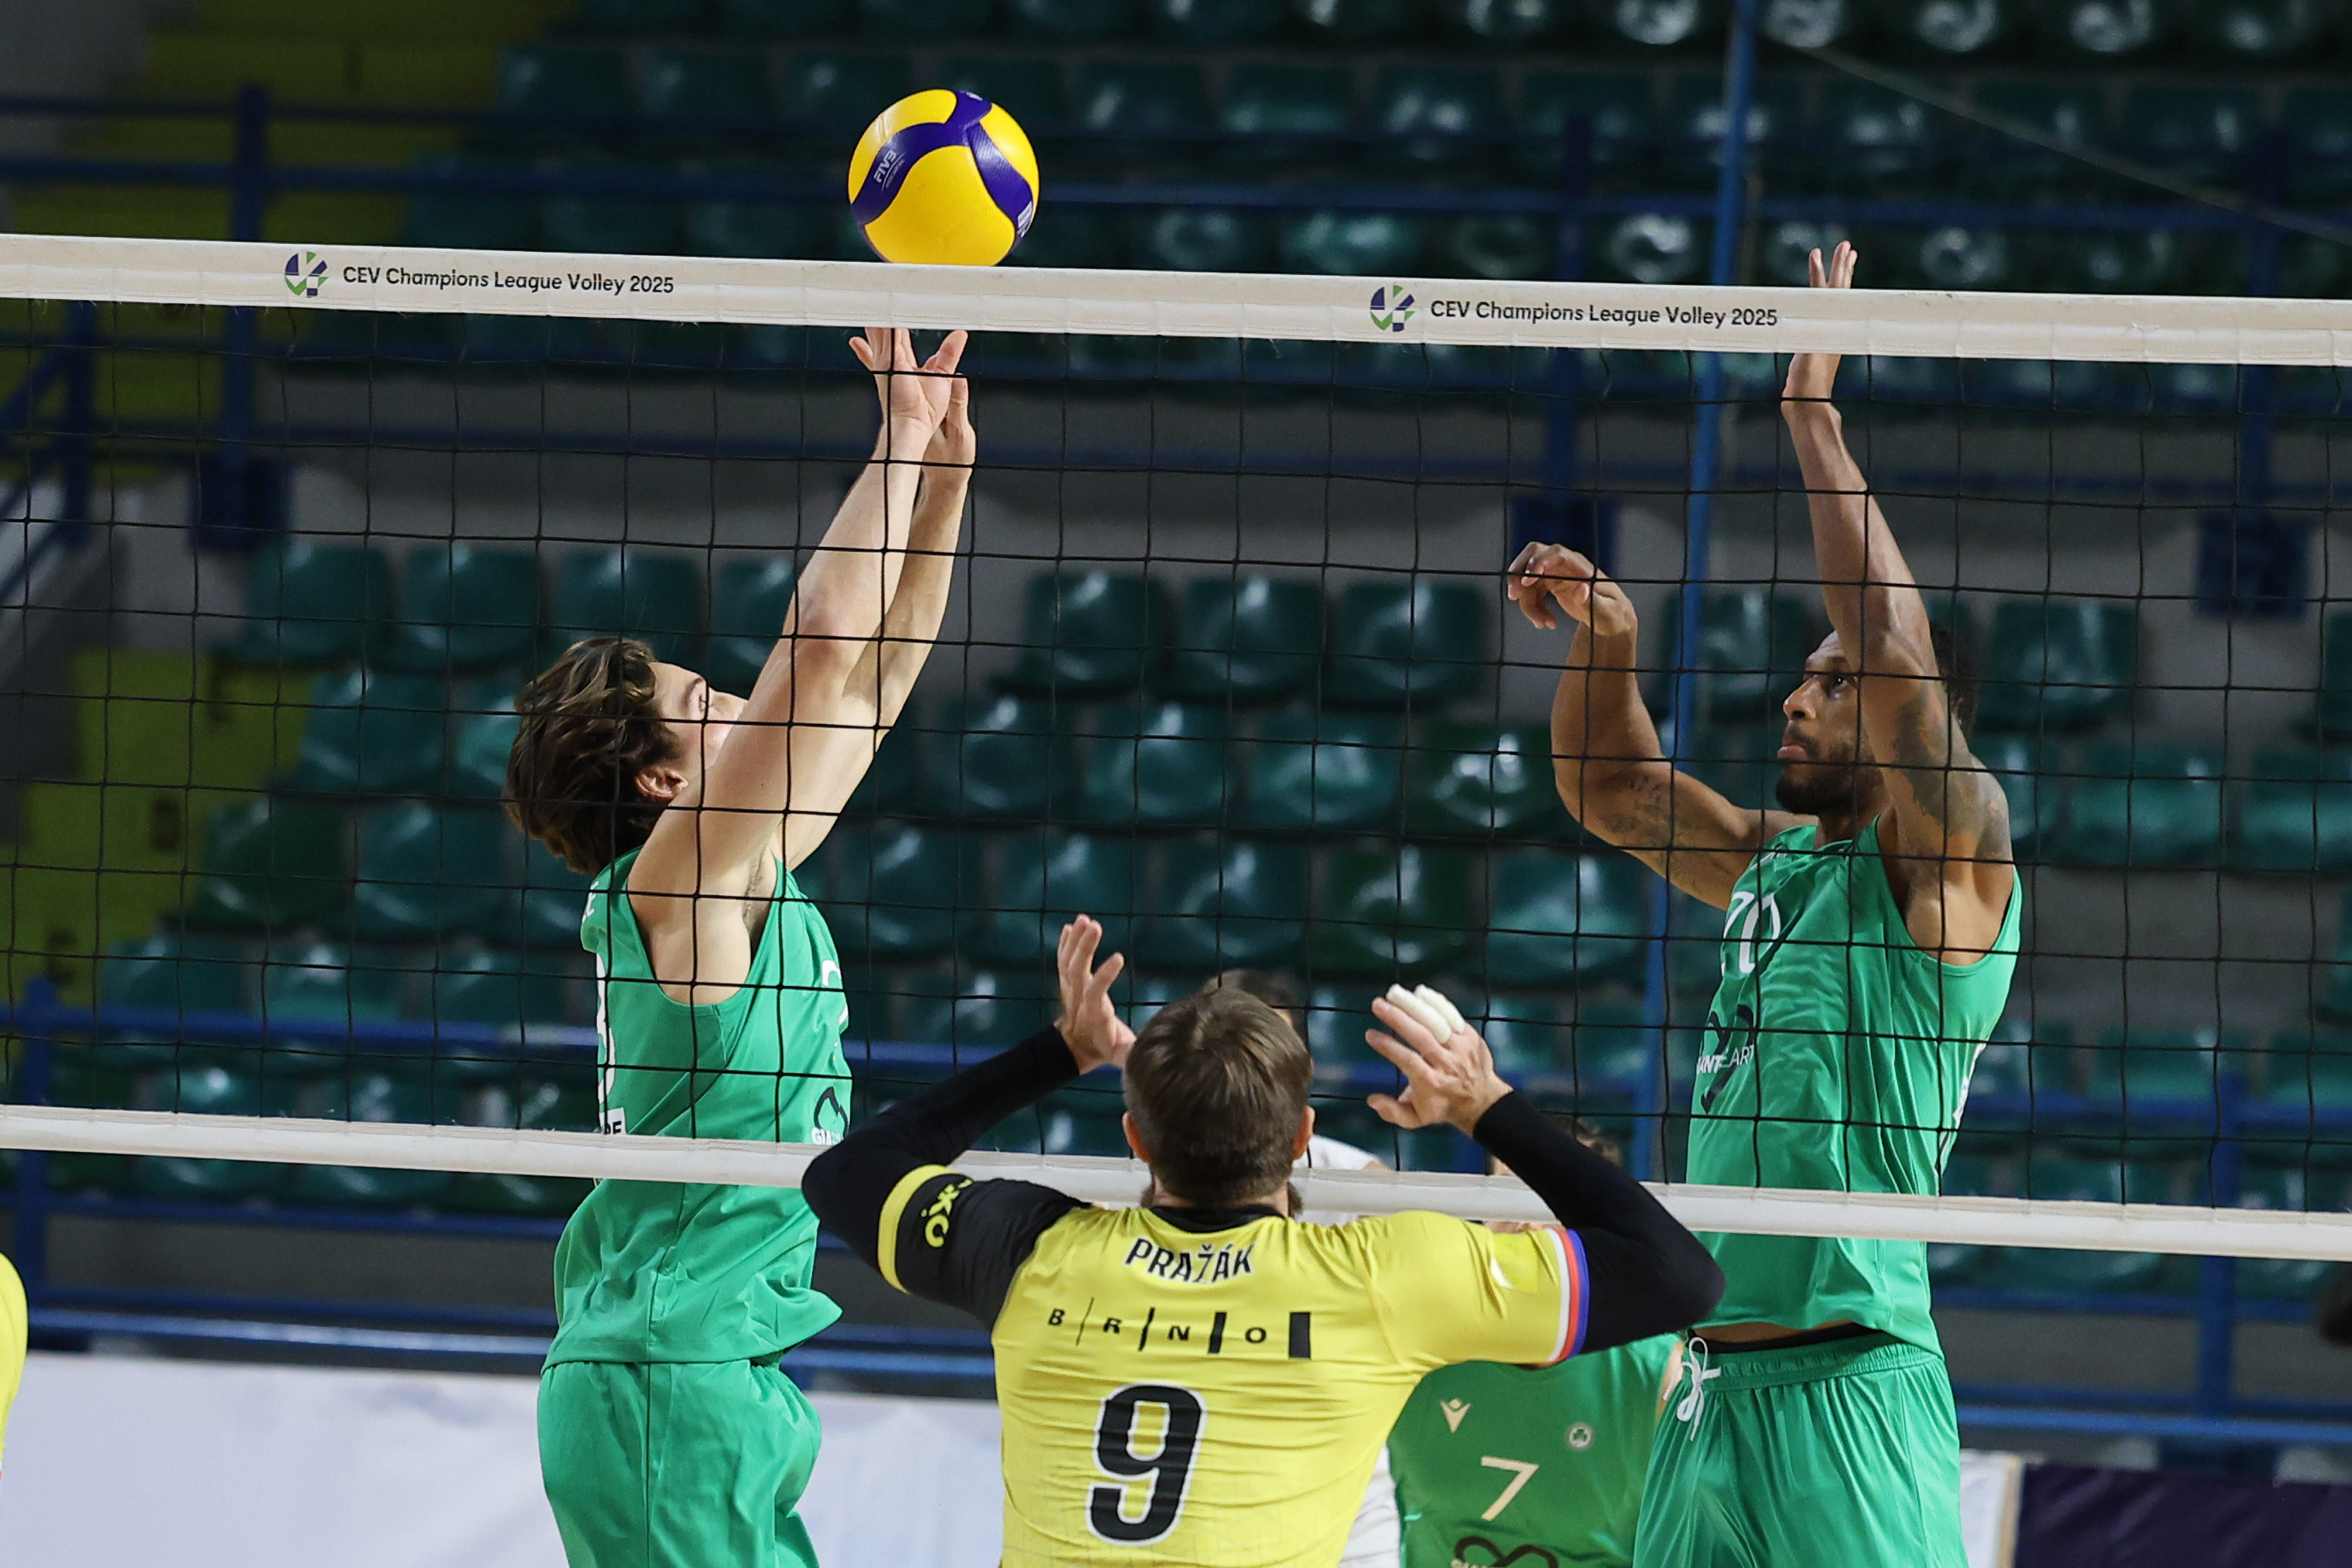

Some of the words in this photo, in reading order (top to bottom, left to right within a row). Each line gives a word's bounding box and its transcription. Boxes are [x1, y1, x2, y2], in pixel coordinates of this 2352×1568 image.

[343, 266, 380, 284] CEV
[386, 267, 489, 291] Champions
[494, 271, 562, 293] League
[566, 273, 625, 296] Volley
[629, 275, 674, 294] 2025
[1430, 299, 1470, 318] CEV
[1475, 300, 1584, 325] Champions
[1589, 304, 1660, 327] League
[1665, 305, 1727, 329] Volley
[1731, 308, 1778, 327] 2025
[1125, 1237, 1253, 1283] PRAŽÁK
[1090, 1384, 1203, 1542] 9
[1480, 1455, 1540, 1522] 7
